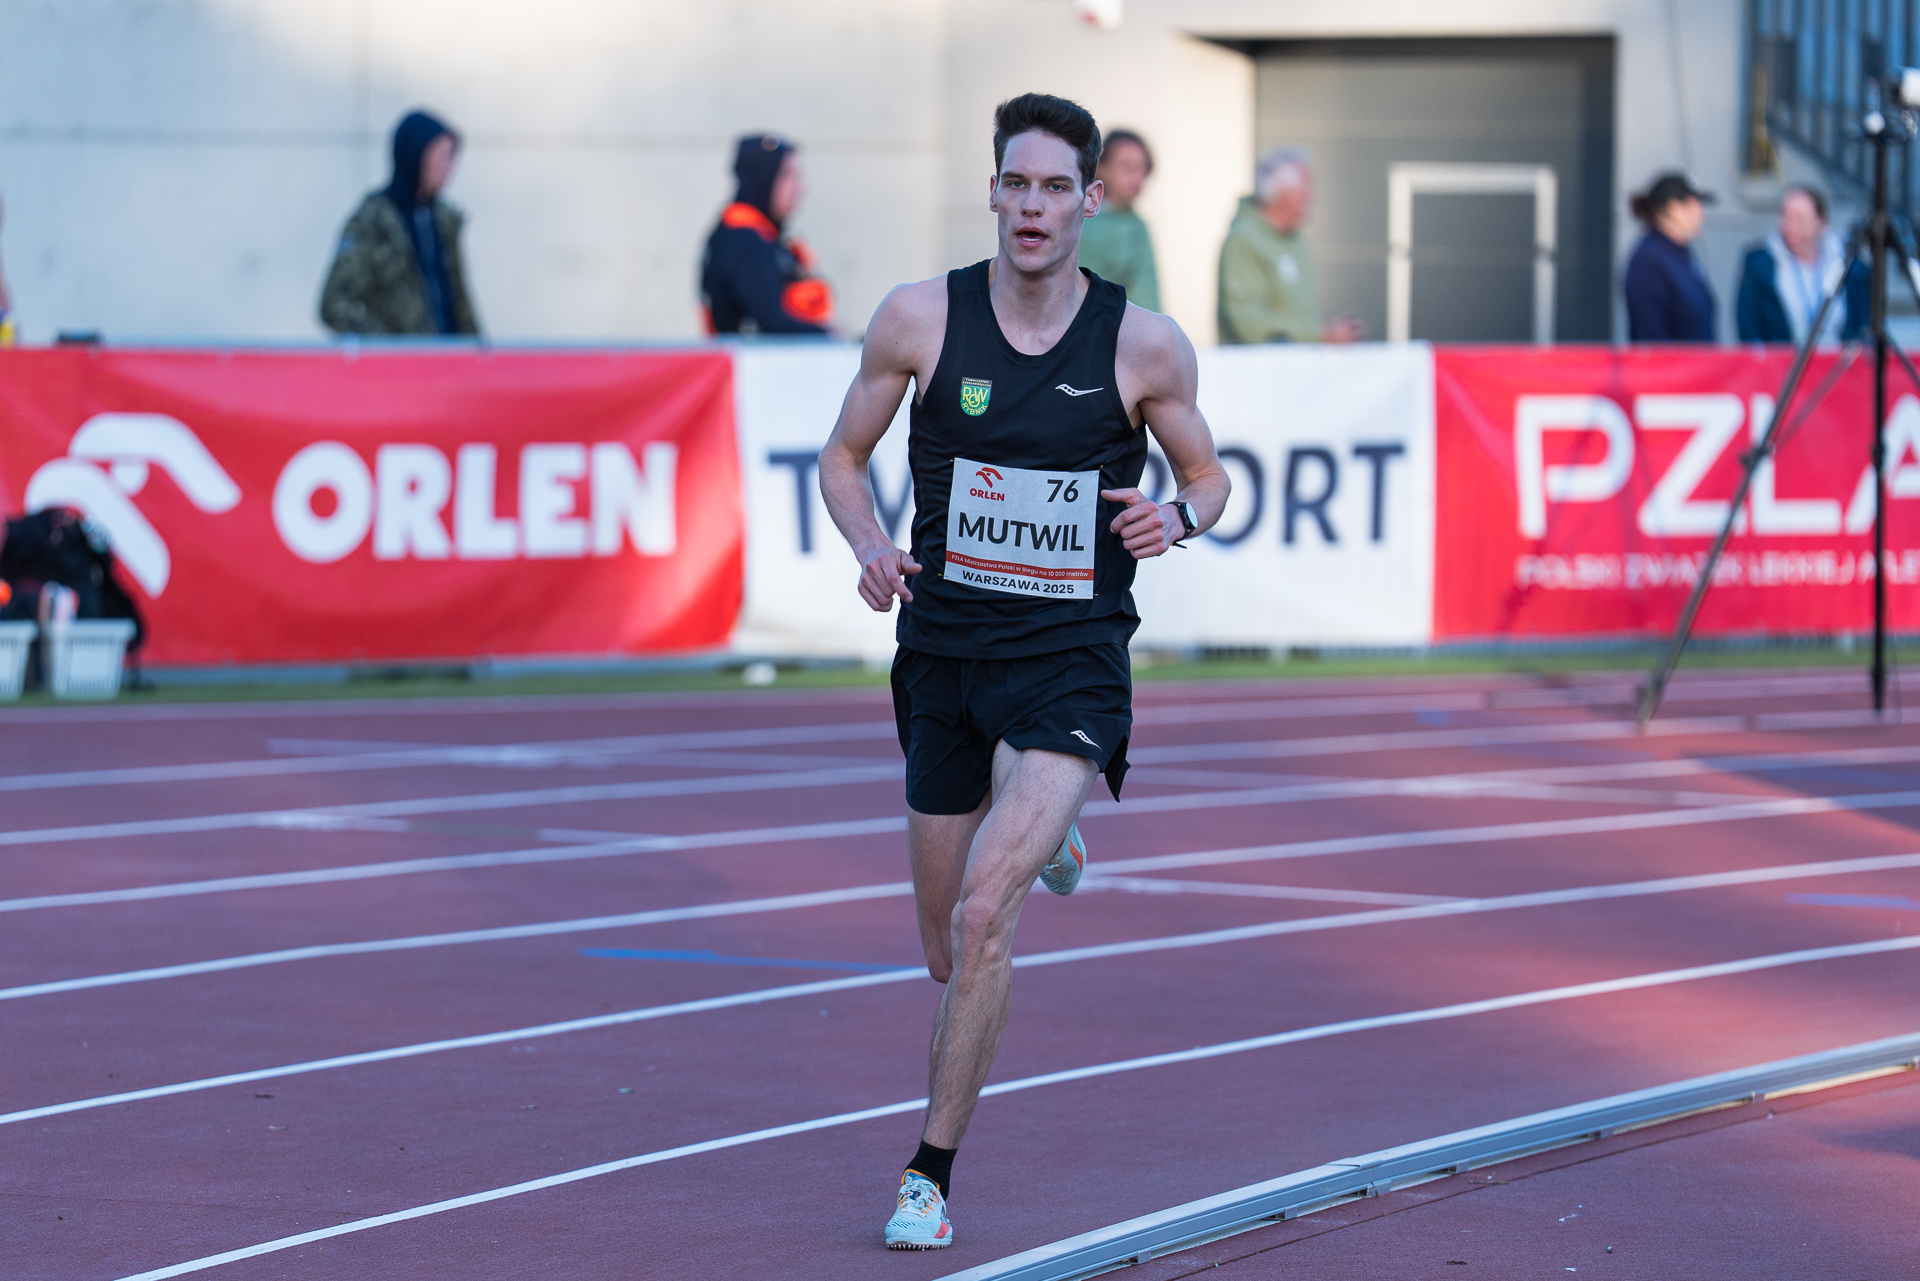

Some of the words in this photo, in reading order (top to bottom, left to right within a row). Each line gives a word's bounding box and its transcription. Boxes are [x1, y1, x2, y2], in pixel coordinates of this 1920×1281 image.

[961, 402, 988, 415] RYBNIK
[272, 440, 678, 563] ORLEN
[969, 487, 1006, 502] ORLEN
[1046, 479, 1080, 503] 76
[958, 511, 1085, 552] MUTWIL
[951, 554, 964, 562] PZLA
[964, 558, 998, 569] Mistrzostwa
[998, 563, 1015, 571] Polski
[962, 569, 1041, 592] WARSZAWA
[1042, 583, 1075, 594] 2025
